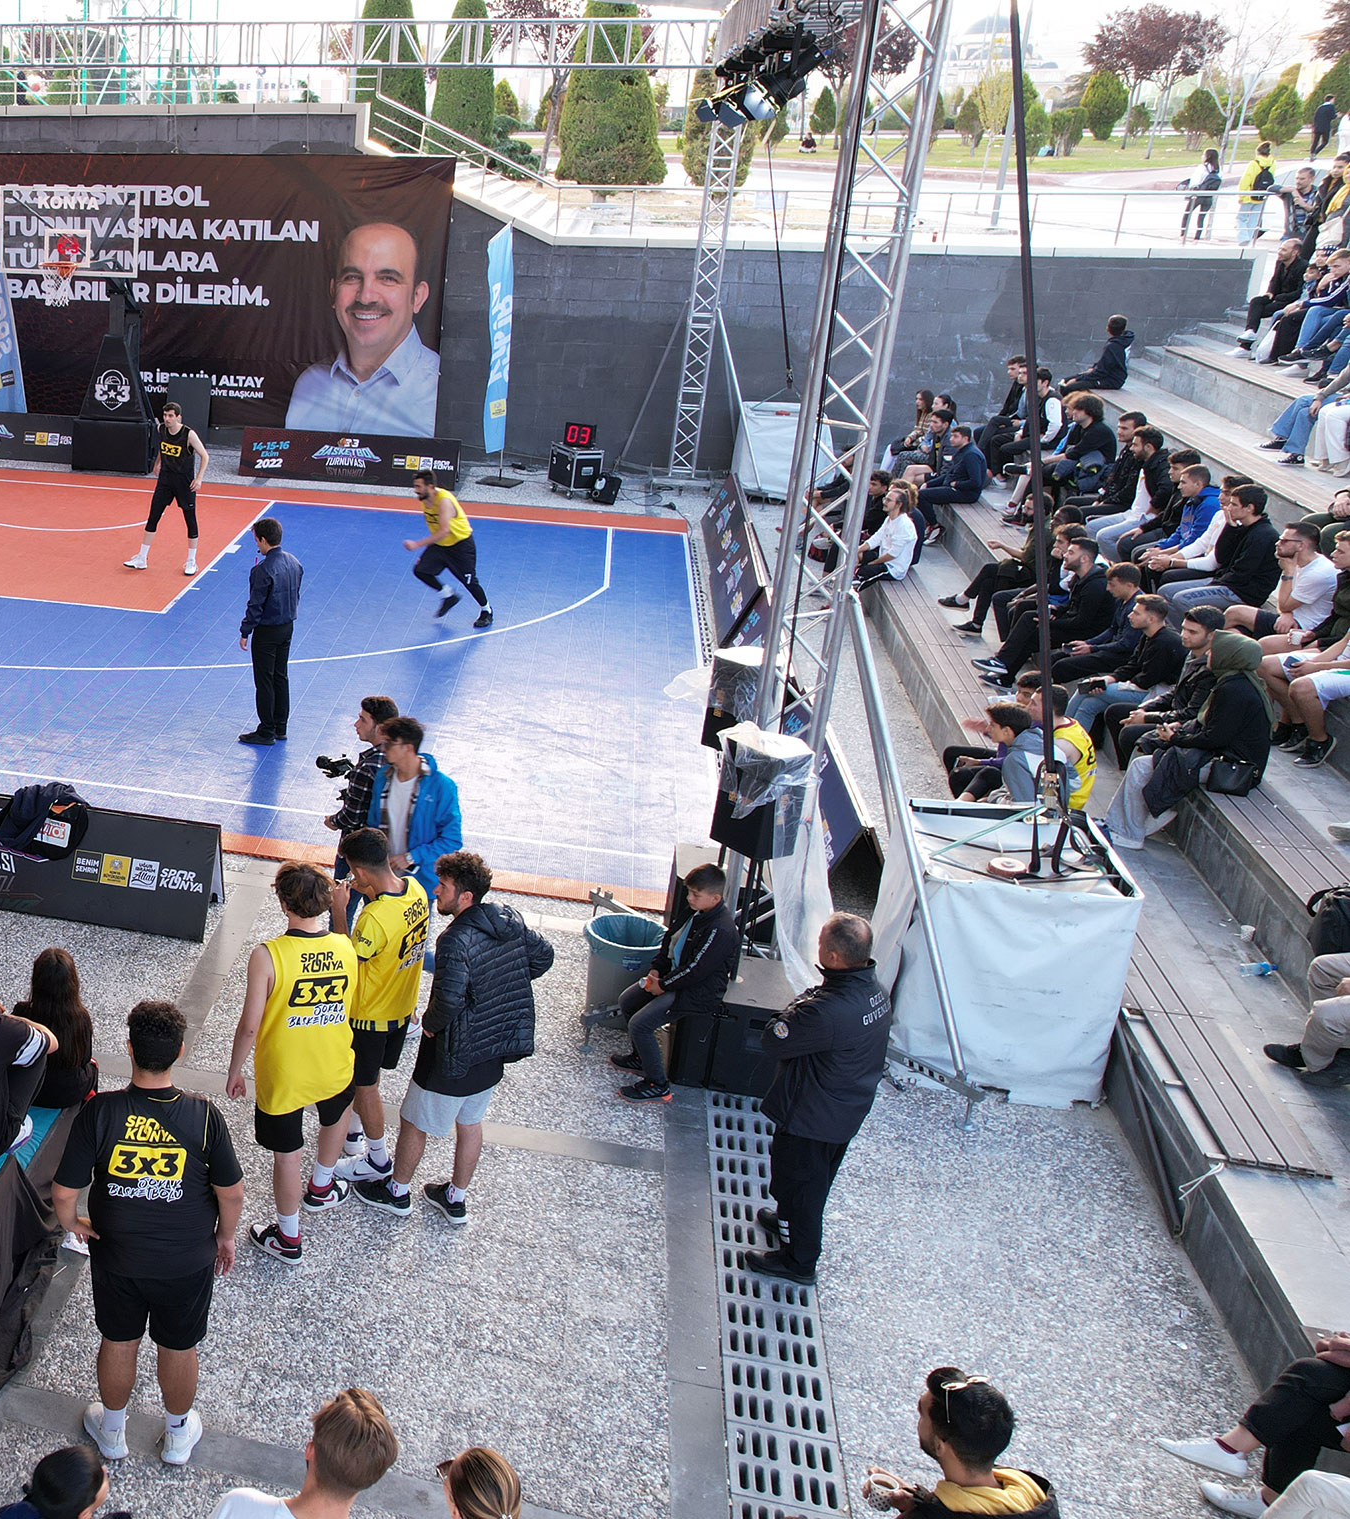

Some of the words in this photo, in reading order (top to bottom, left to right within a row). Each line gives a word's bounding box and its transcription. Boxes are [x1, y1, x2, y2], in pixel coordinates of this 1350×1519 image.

[37, 196, 99, 210] KONYA
[203, 217, 320, 242] KATILAN
[6, 278, 150, 304] BAŞARILR
[156, 276, 271, 307] DİLERİM.
[219, 375, 265, 388] ALTAY
[229, 390, 264, 400] BAŞKANI
[566, 425, 591, 444] 03
[161, 442, 181, 456] 3x3
[252, 440, 290, 451] 14-15-16
[261, 450, 279, 458] Ekim
[312, 445, 382, 463] BASKETBOL
[254, 458, 283, 469] 2022
[326, 457, 366, 468] TURNUVASI
[464, 573, 472, 584] 7
[76, 857, 100, 867] BENİM
[75, 865, 98, 875] ŞEHRİM
[160, 867, 196, 881] SPOR
[159, 877, 203, 894] KONYA
[300, 951, 334, 964] SPOR
[302, 959, 344, 973] KONYA
[293, 978, 348, 1005] 3x3
[287, 1012, 347, 1029] BASKETBOLU
[125, 1114, 165, 1130] SPO
[114, 1149, 179, 1178] 3x3
